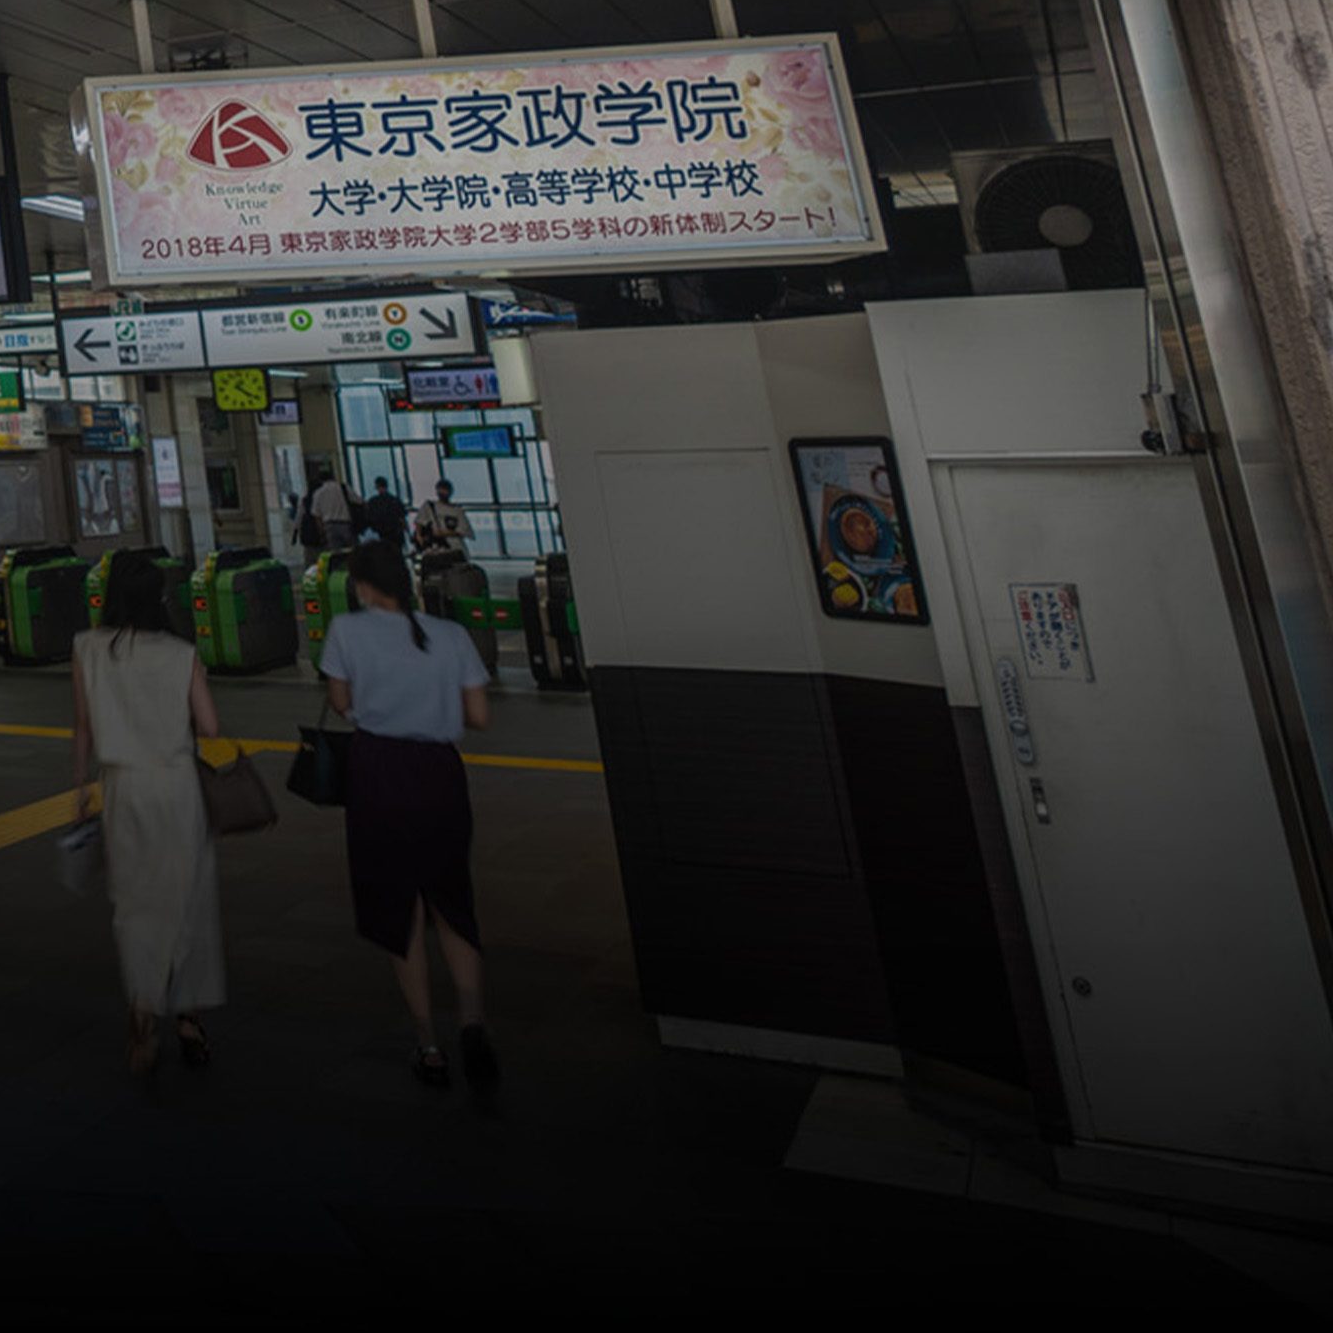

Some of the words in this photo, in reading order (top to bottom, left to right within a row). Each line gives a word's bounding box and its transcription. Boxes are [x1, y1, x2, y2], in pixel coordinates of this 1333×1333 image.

[297, 75, 749, 162] 東京家政学院
[205, 180, 284, 198] Knowledge
[308, 158, 764, 218] 大学・大学院・高等学校・中学校
[223, 197, 269, 210] Virtue
[238, 213, 262, 227] Art
[140, 231, 274, 262] 2018年4月
